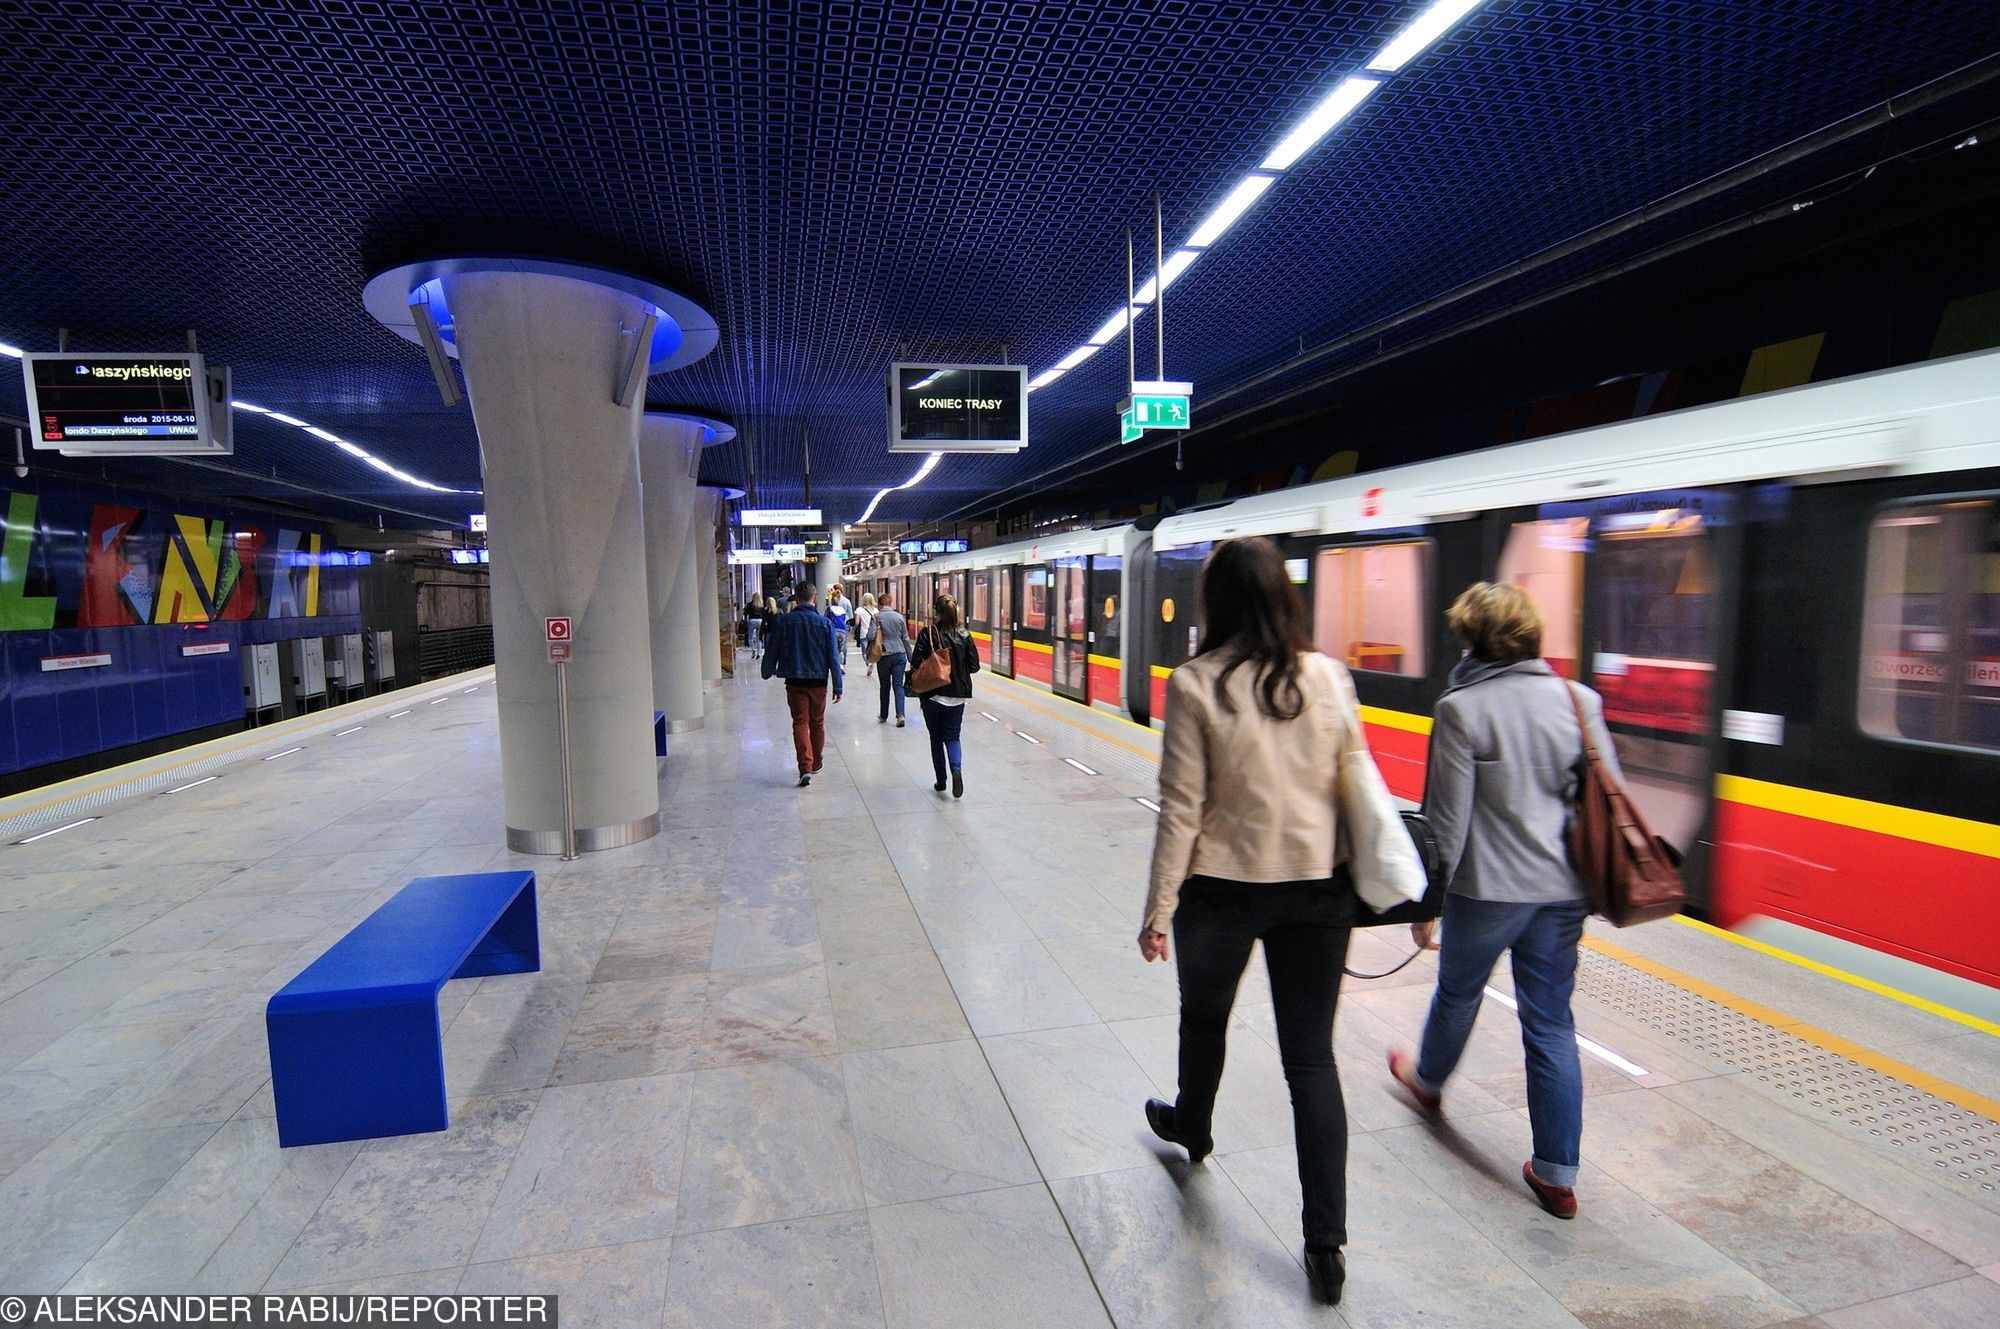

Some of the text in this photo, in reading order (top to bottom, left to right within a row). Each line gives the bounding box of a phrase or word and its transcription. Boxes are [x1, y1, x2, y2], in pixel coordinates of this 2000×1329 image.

[92, 365, 192, 381] aszyńskiego
[919, 398, 1002, 410] KONIEC TRASY
[123, 415, 195, 424] środa 2015-06-10
[91, 426, 148, 436] Daszyńskiego
[1872, 660, 1999, 680] Dworzec ileń
